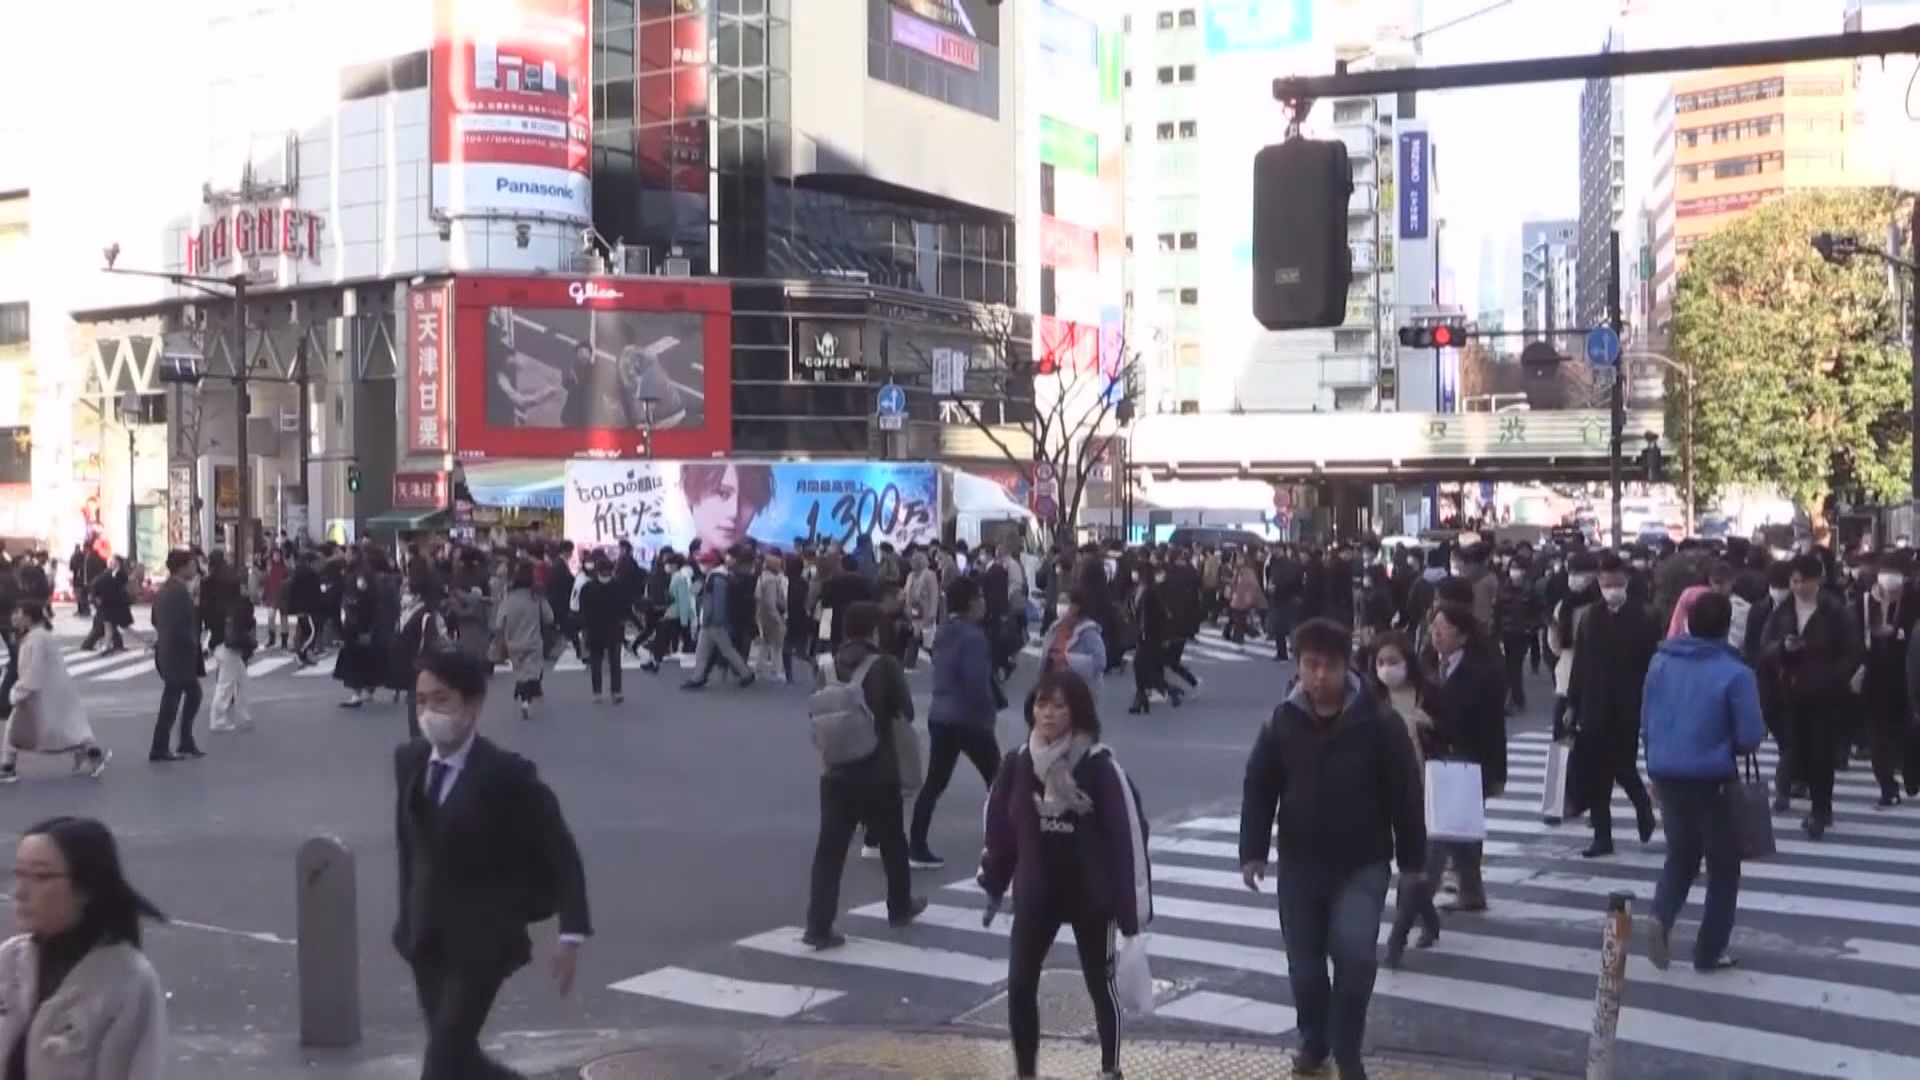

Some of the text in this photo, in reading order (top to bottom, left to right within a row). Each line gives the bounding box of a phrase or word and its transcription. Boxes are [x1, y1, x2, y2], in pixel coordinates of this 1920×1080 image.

[496, 177, 574, 199] Panasonic
[187, 208, 326, 272] MAGNET
[569, 282, 623, 305] Glico
[805, 357, 850, 368] COFFEE
[418, 313, 439, 446] 天津甘栗
